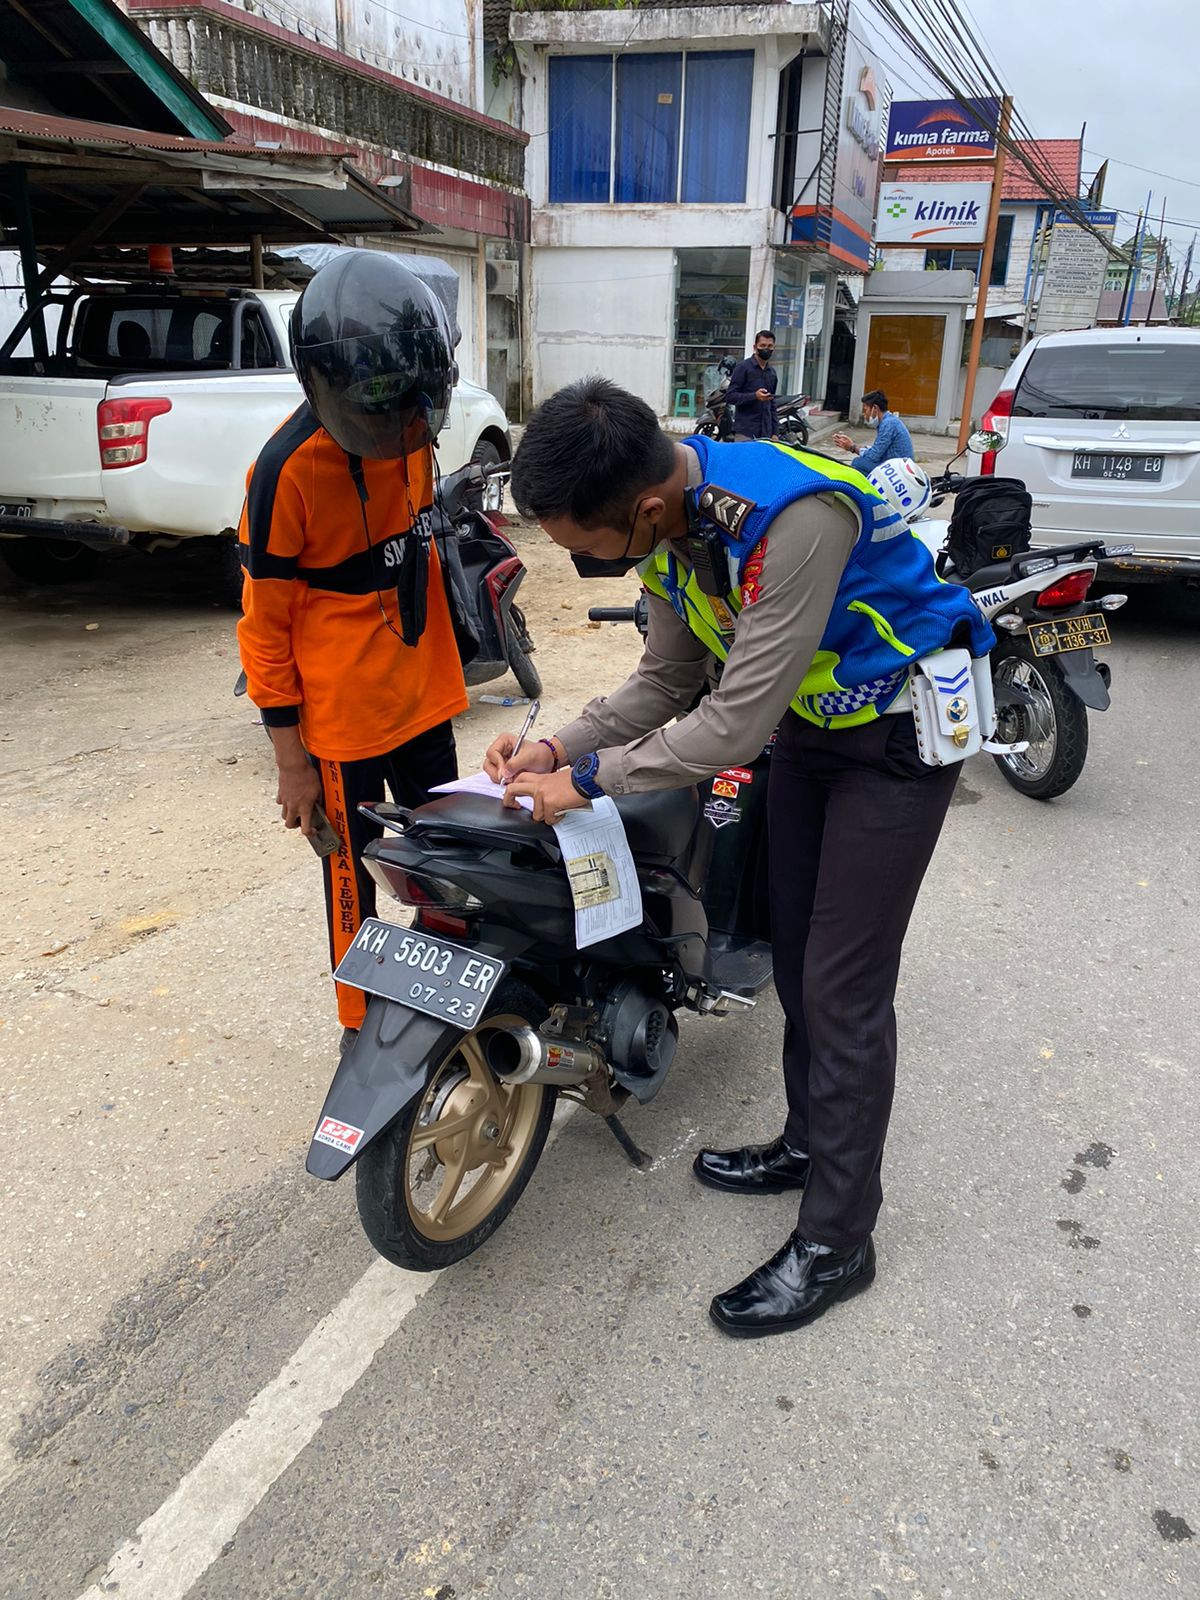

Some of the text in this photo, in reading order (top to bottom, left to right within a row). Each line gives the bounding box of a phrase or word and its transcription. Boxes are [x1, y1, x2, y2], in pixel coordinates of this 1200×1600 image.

[893, 128, 989, 145] kimia farma
[925, 146, 956, 156] Apotek
[914, 200, 981, 220] klinik
[1074, 455, 1092, 470] KH
[1102, 456, 1132, 472] 1148
[880, 463, 908, 498] POLISI
[338, 876, 355, 934] TEWEH
[356, 925, 495, 993] KH 5603 ER
